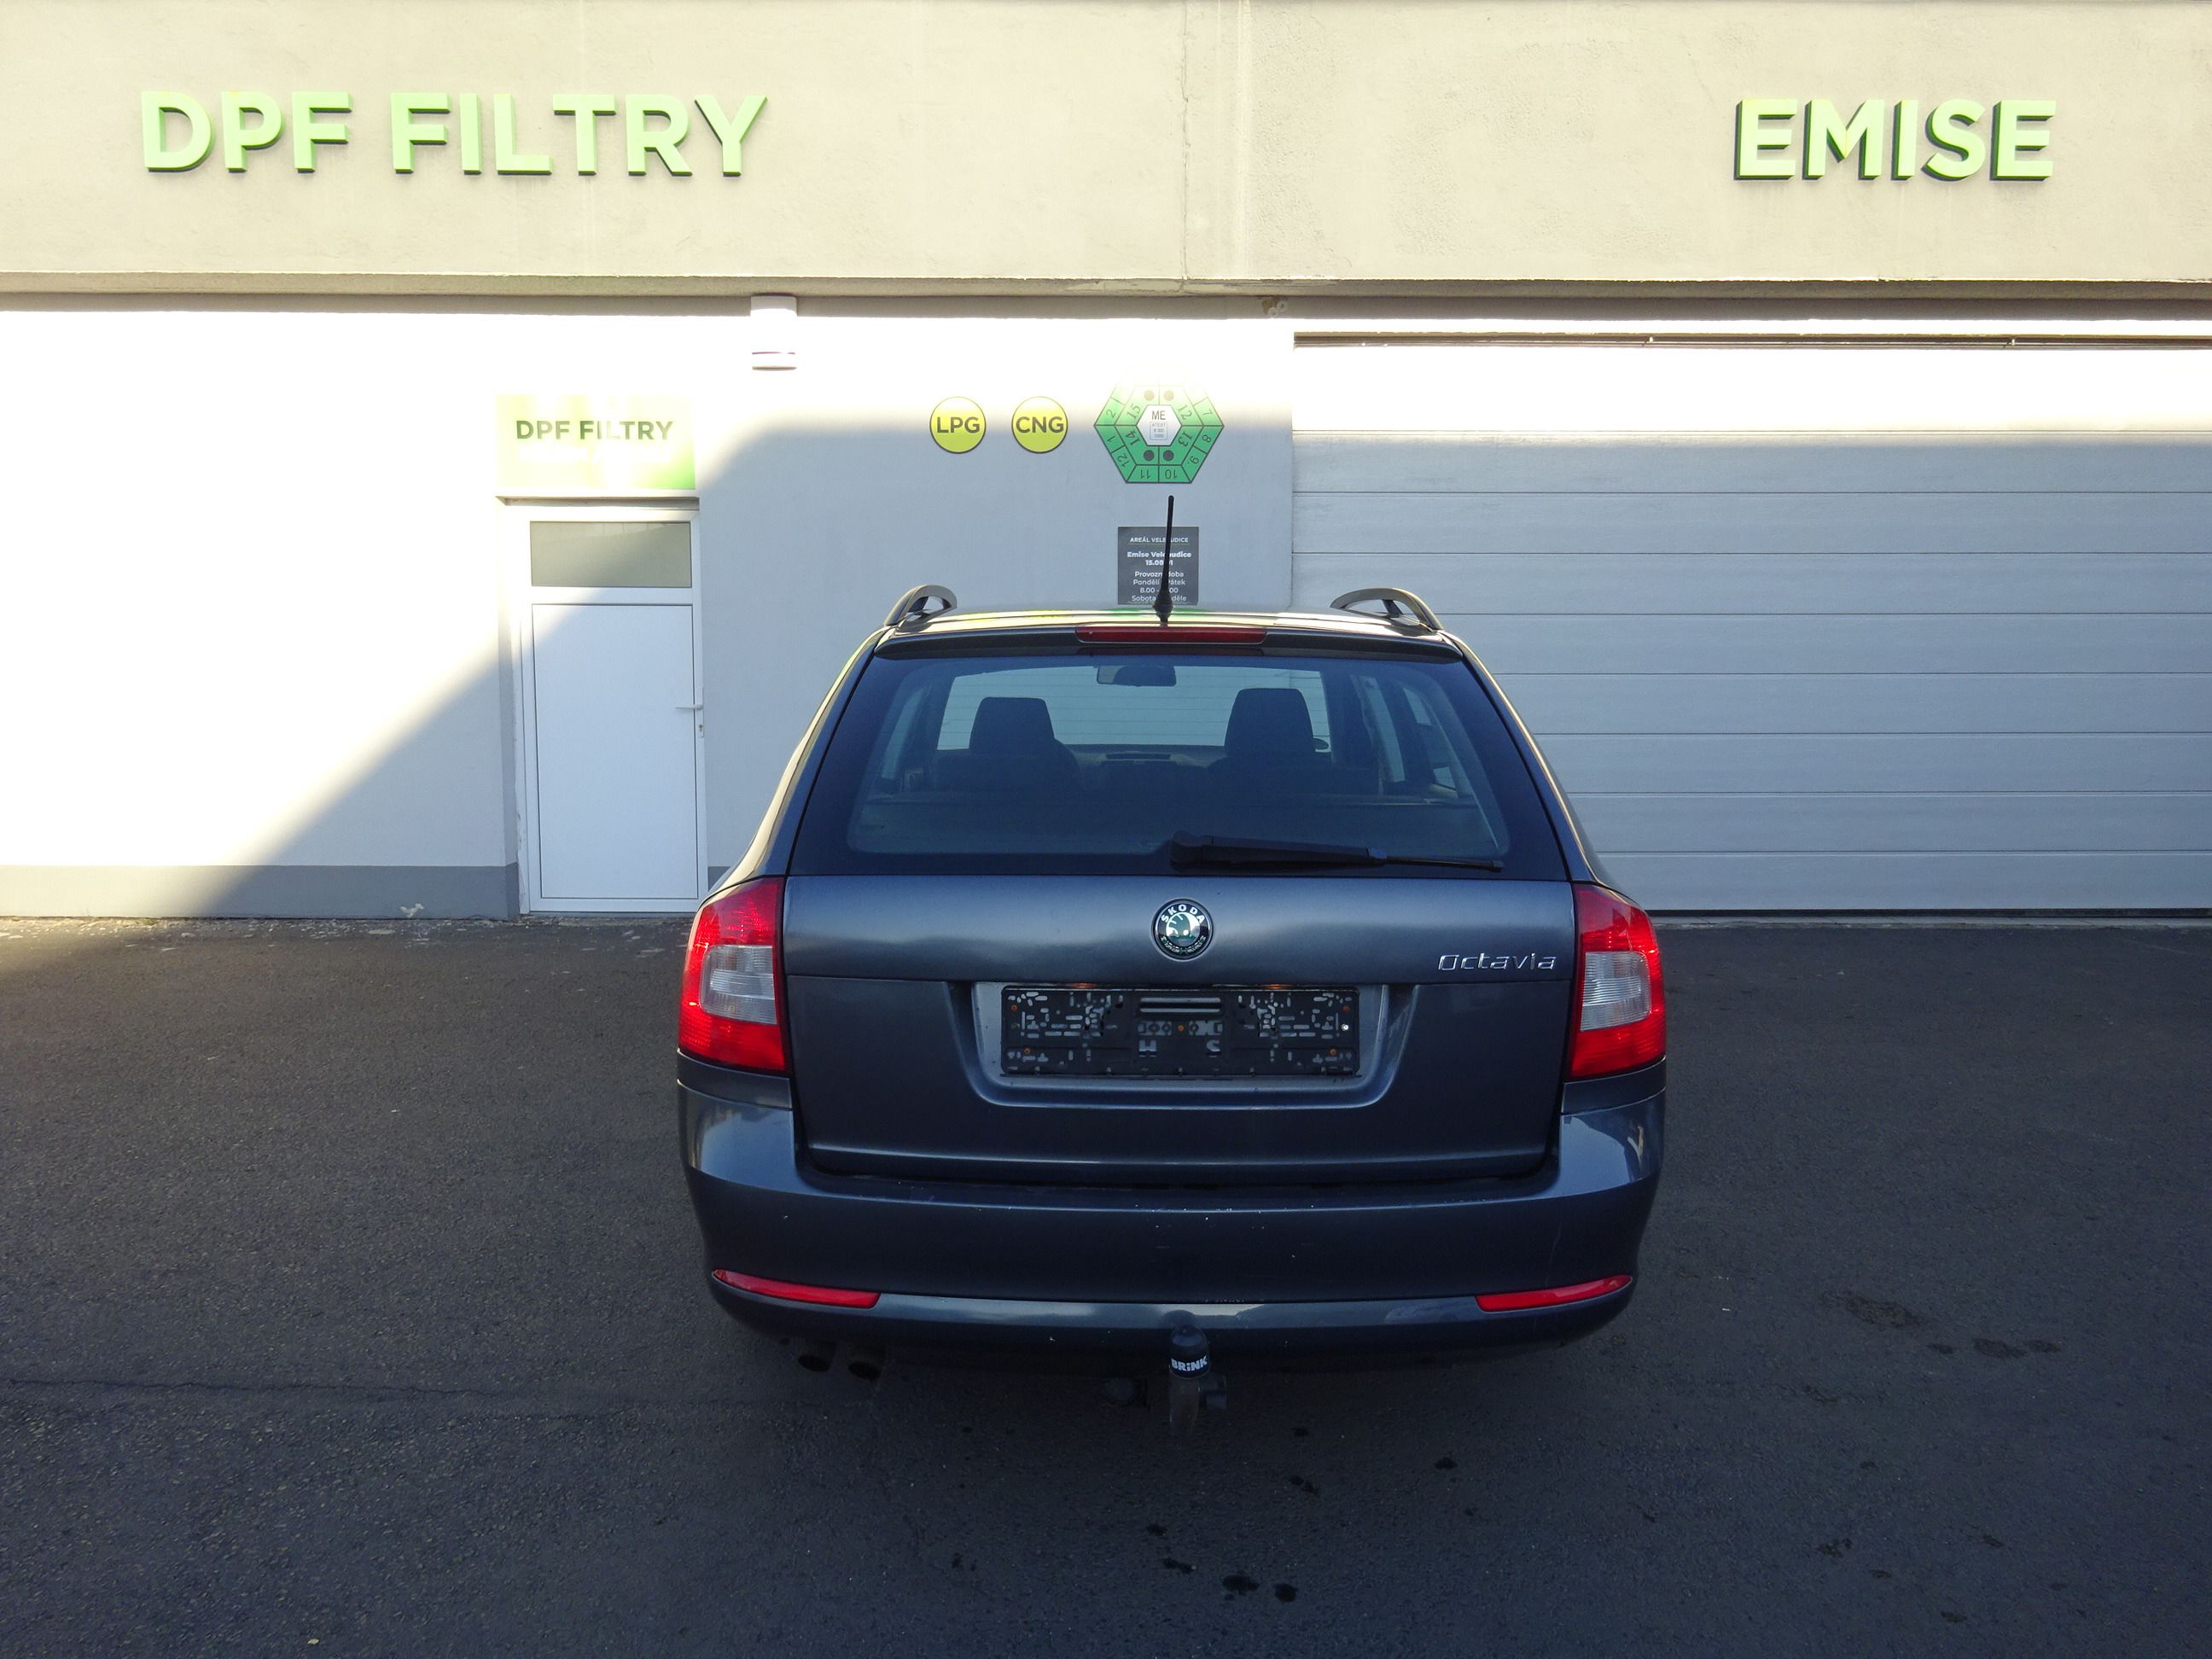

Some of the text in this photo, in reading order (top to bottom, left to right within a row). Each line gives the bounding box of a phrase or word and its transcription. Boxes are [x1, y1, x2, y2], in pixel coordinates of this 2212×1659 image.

[141, 91, 768, 176] DPF FILTRY
[1734, 98, 2057, 181] EMISE
[1151, 410, 1167, 420] ME
[516, 420, 673, 440] DPF FILTRY
[936, 416, 981, 434] LPG
[1016, 416, 1064, 434] CNG
[1438, 952, 1557, 970] Octavia
